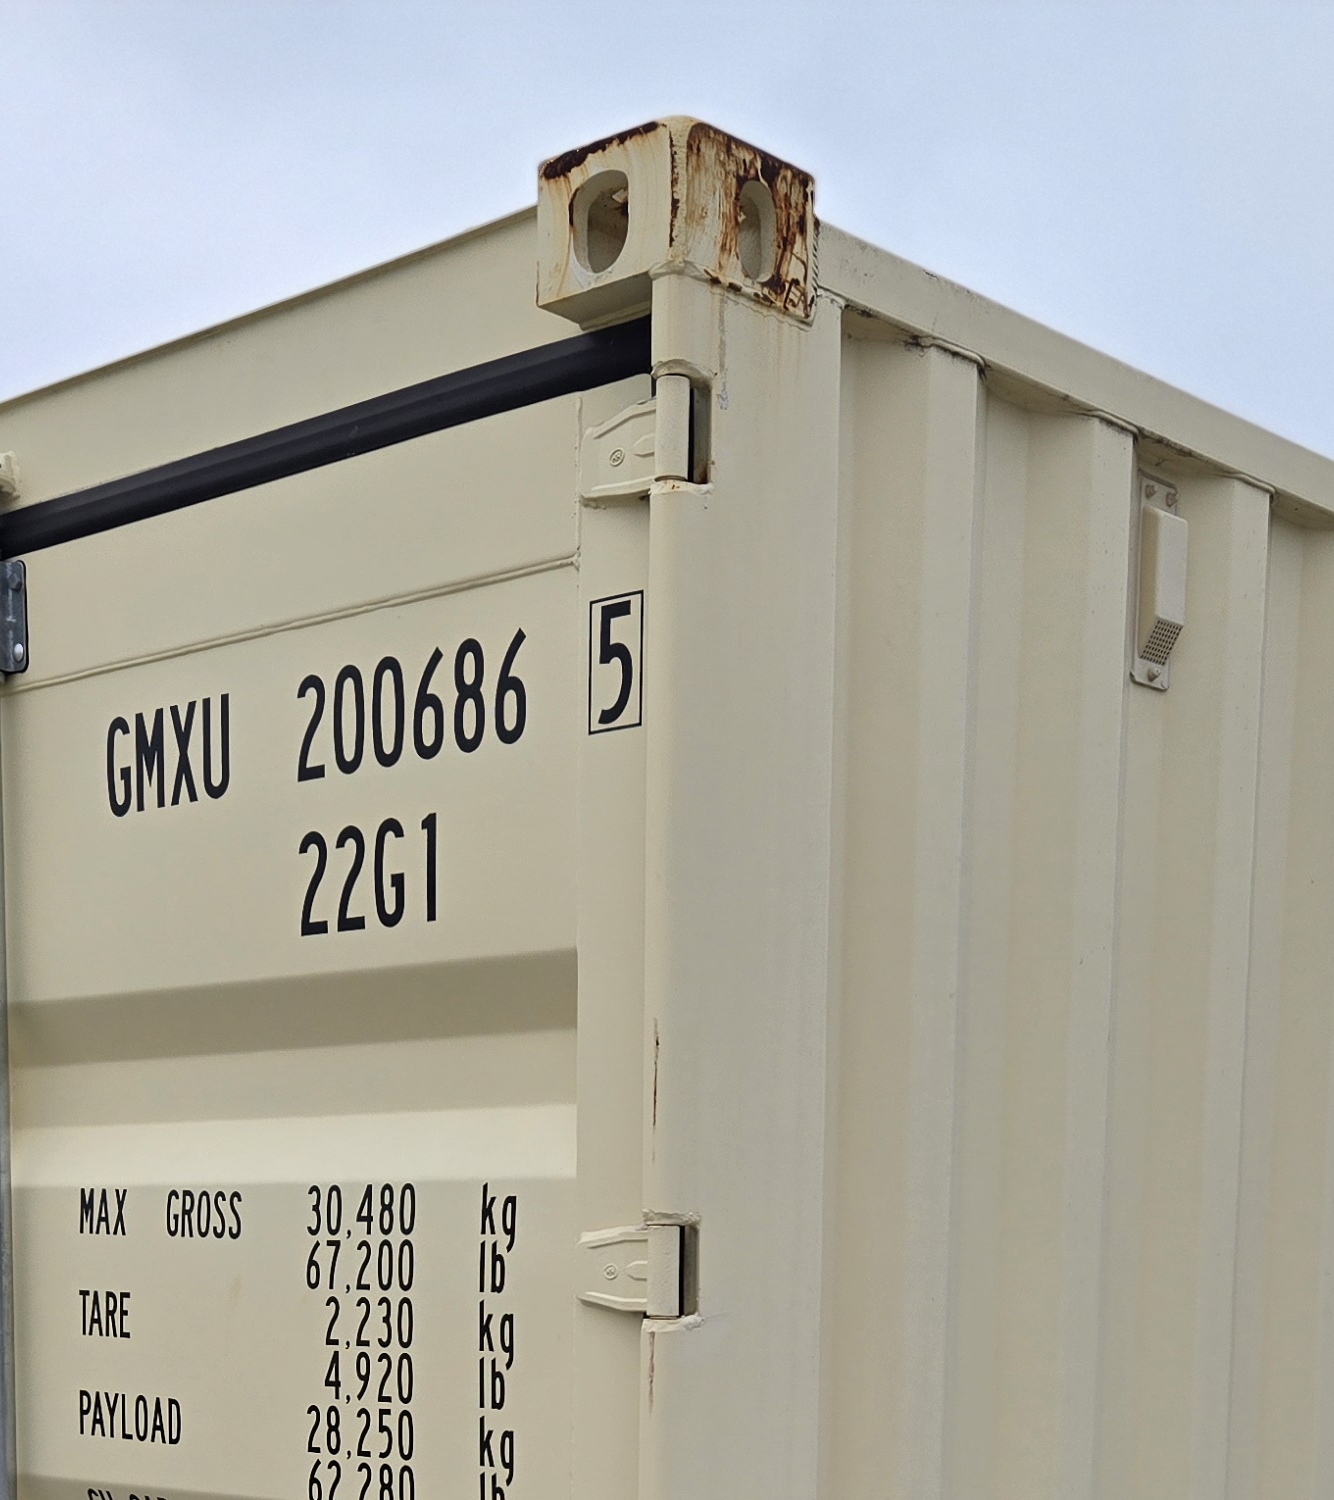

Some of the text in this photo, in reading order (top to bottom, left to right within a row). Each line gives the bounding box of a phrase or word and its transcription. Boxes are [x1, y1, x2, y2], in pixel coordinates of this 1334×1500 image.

[106, 599, 634, 818] GMXU 200686 5
[298, 812, 438, 937] 22G1
[79, 1182, 517, 1253] MAX GROSS 30,480 kg
[306, 1239, 506, 1294] 67,200 lb
[79, 1289, 515, 1371] TARE 2,230 kg
[324, 1351, 505, 1411] 4,920 lb
[79, 1389, 515, 1487] PAYLOAD 28,250 kg
